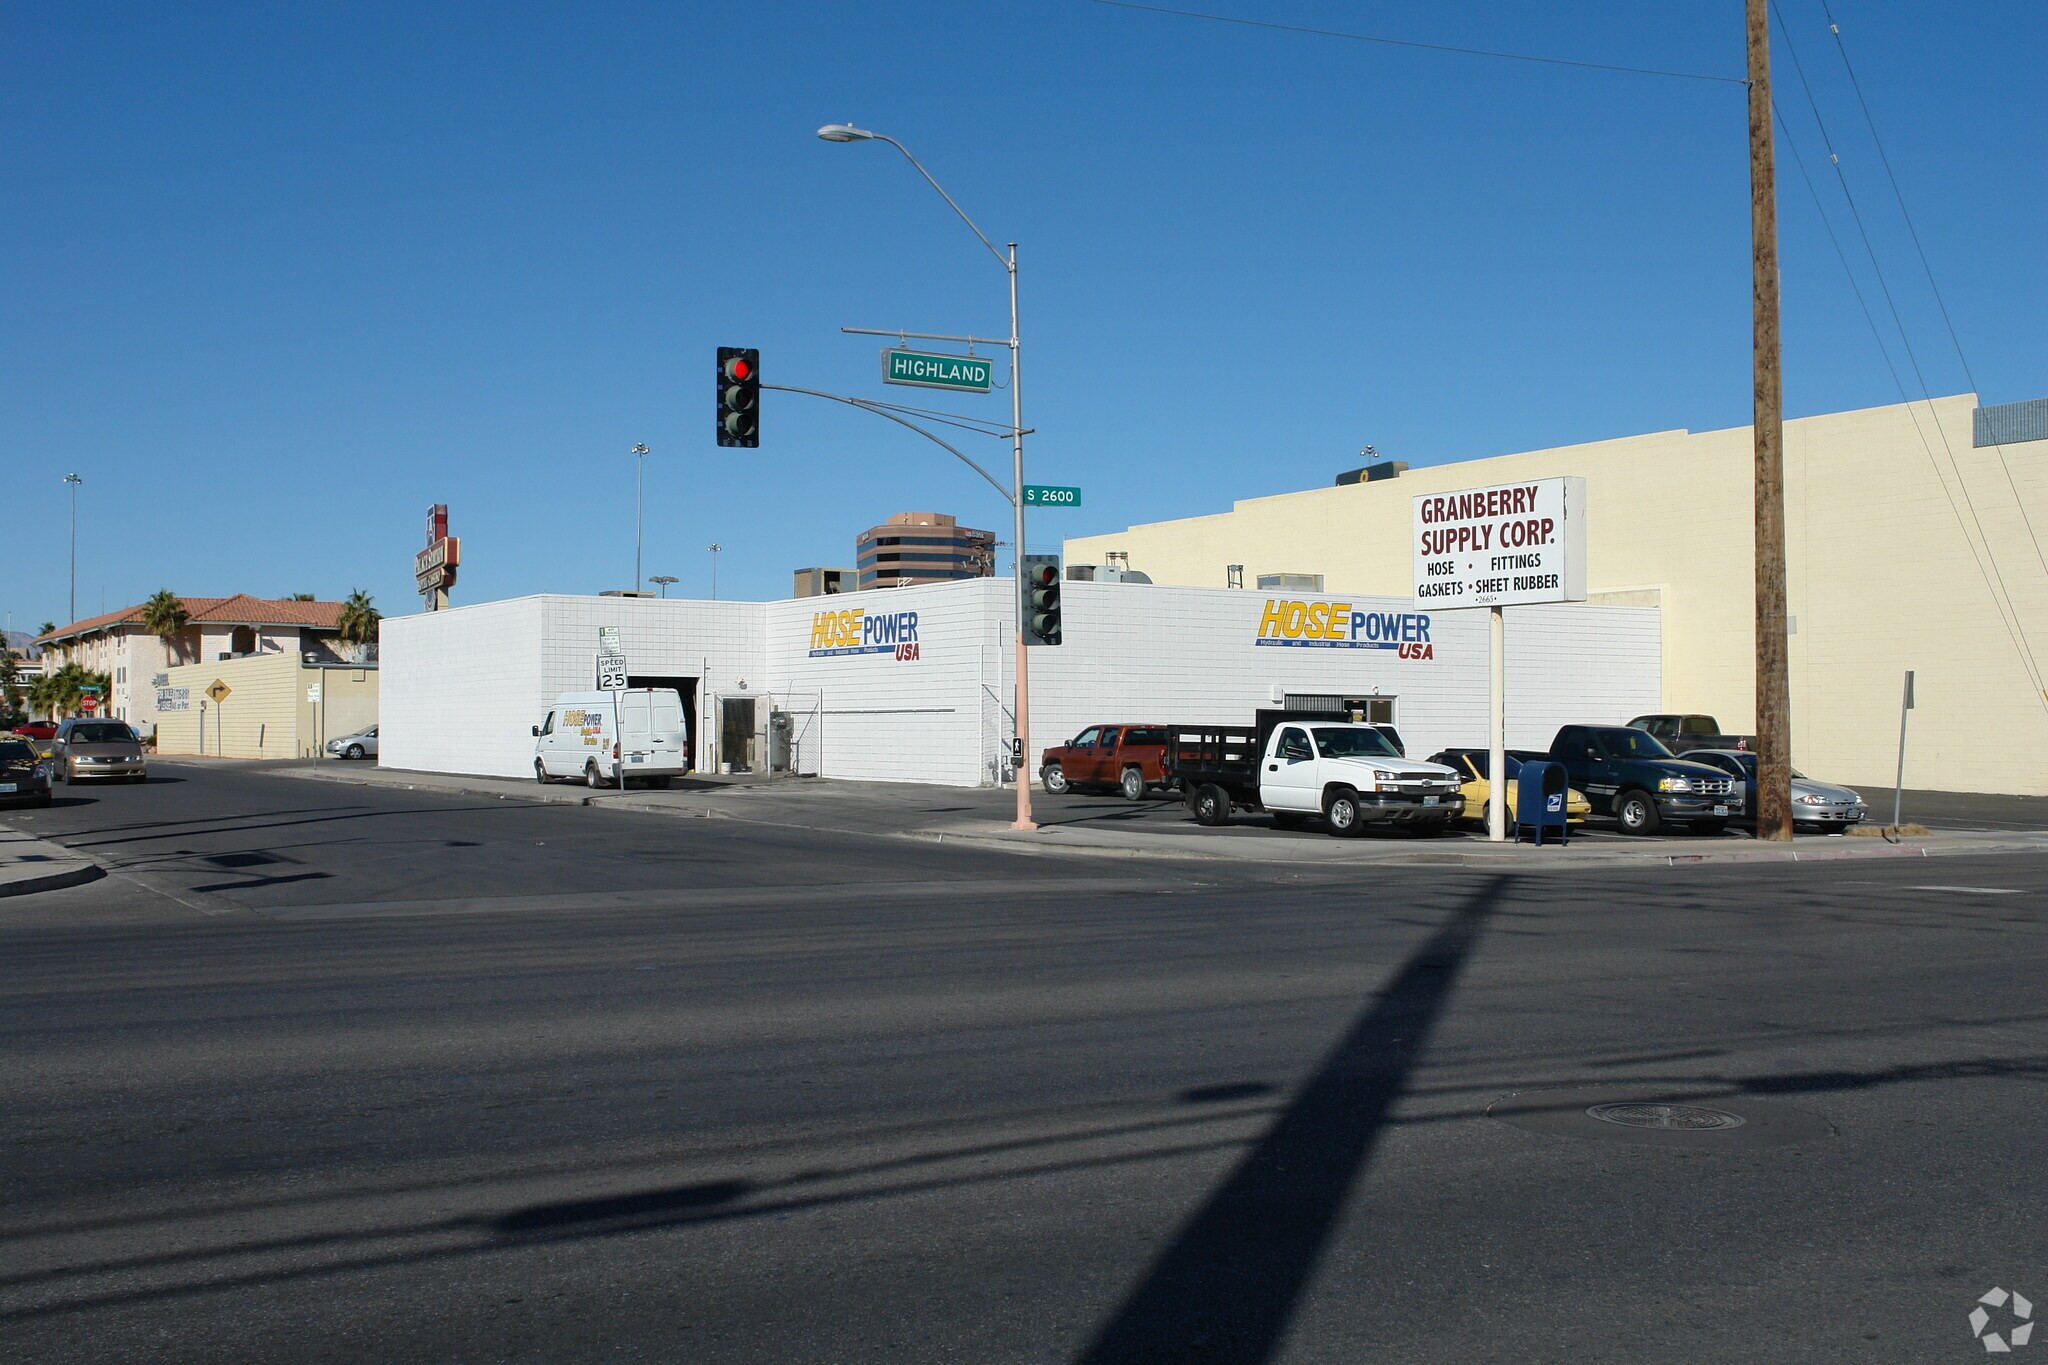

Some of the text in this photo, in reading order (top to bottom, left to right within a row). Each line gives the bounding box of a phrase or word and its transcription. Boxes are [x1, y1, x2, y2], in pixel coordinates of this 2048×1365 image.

[895, 358, 985, 382] HIGHLAND
[1028, 489, 1074, 502] S 2600
[1421, 486, 1538, 524] GRANBERRY
[1421, 518, 1555, 556] SUPPLY CORP.
[1427, 553, 1541, 576] HOSE FITTINGS
[1418, 574, 1558, 598] GASKETS SHEET RUBBER
[810, 608, 918, 648] HOSE POWER
[1258, 600, 1431, 642] HOSE POWER
[896, 643, 919, 661] USA
[1261, 639, 1283, 648] Hydraulic
[1398, 643, 1433, 660] USA
[602, 674, 624, 687] 25
[563, 710, 602, 726] HOSE POWER
